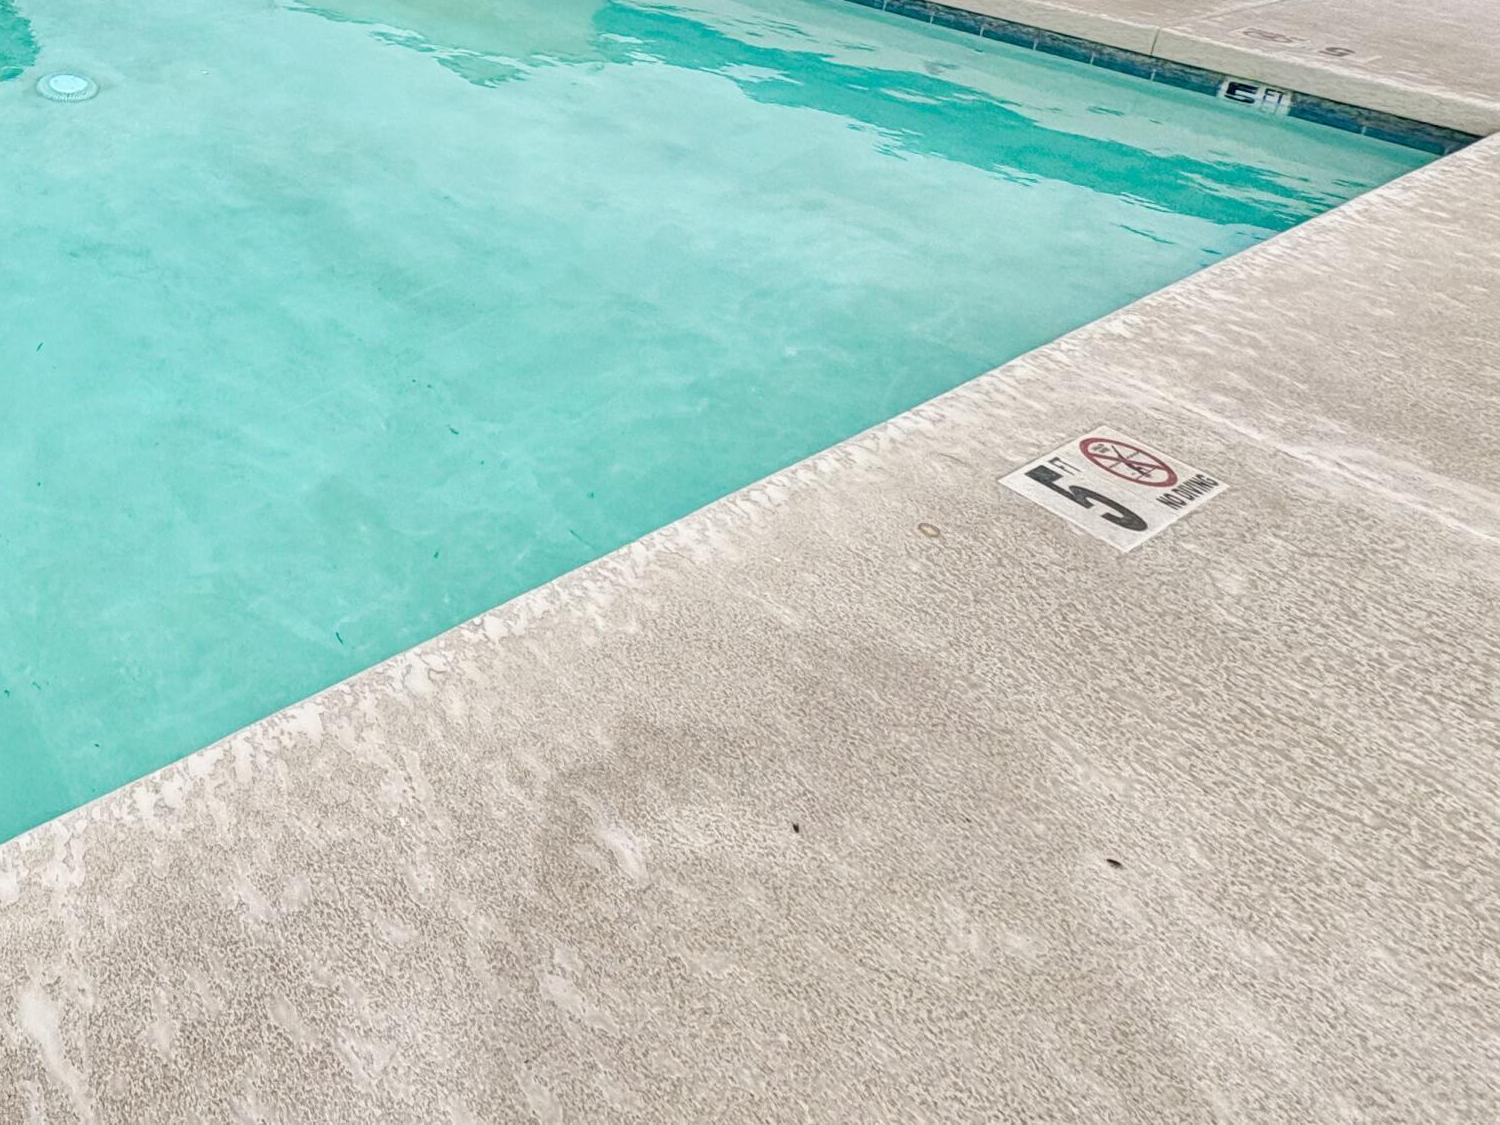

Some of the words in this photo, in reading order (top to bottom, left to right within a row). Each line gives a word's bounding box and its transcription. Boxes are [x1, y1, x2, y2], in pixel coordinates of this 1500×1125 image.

[1224, 81, 1258, 104] 5
[1048, 456, 1082, 476] FT
[1024, 464, 1148, 532] 5
[1170, 474, 1219, 501] DIVING
[1155, 493, 1187, 511] NO
